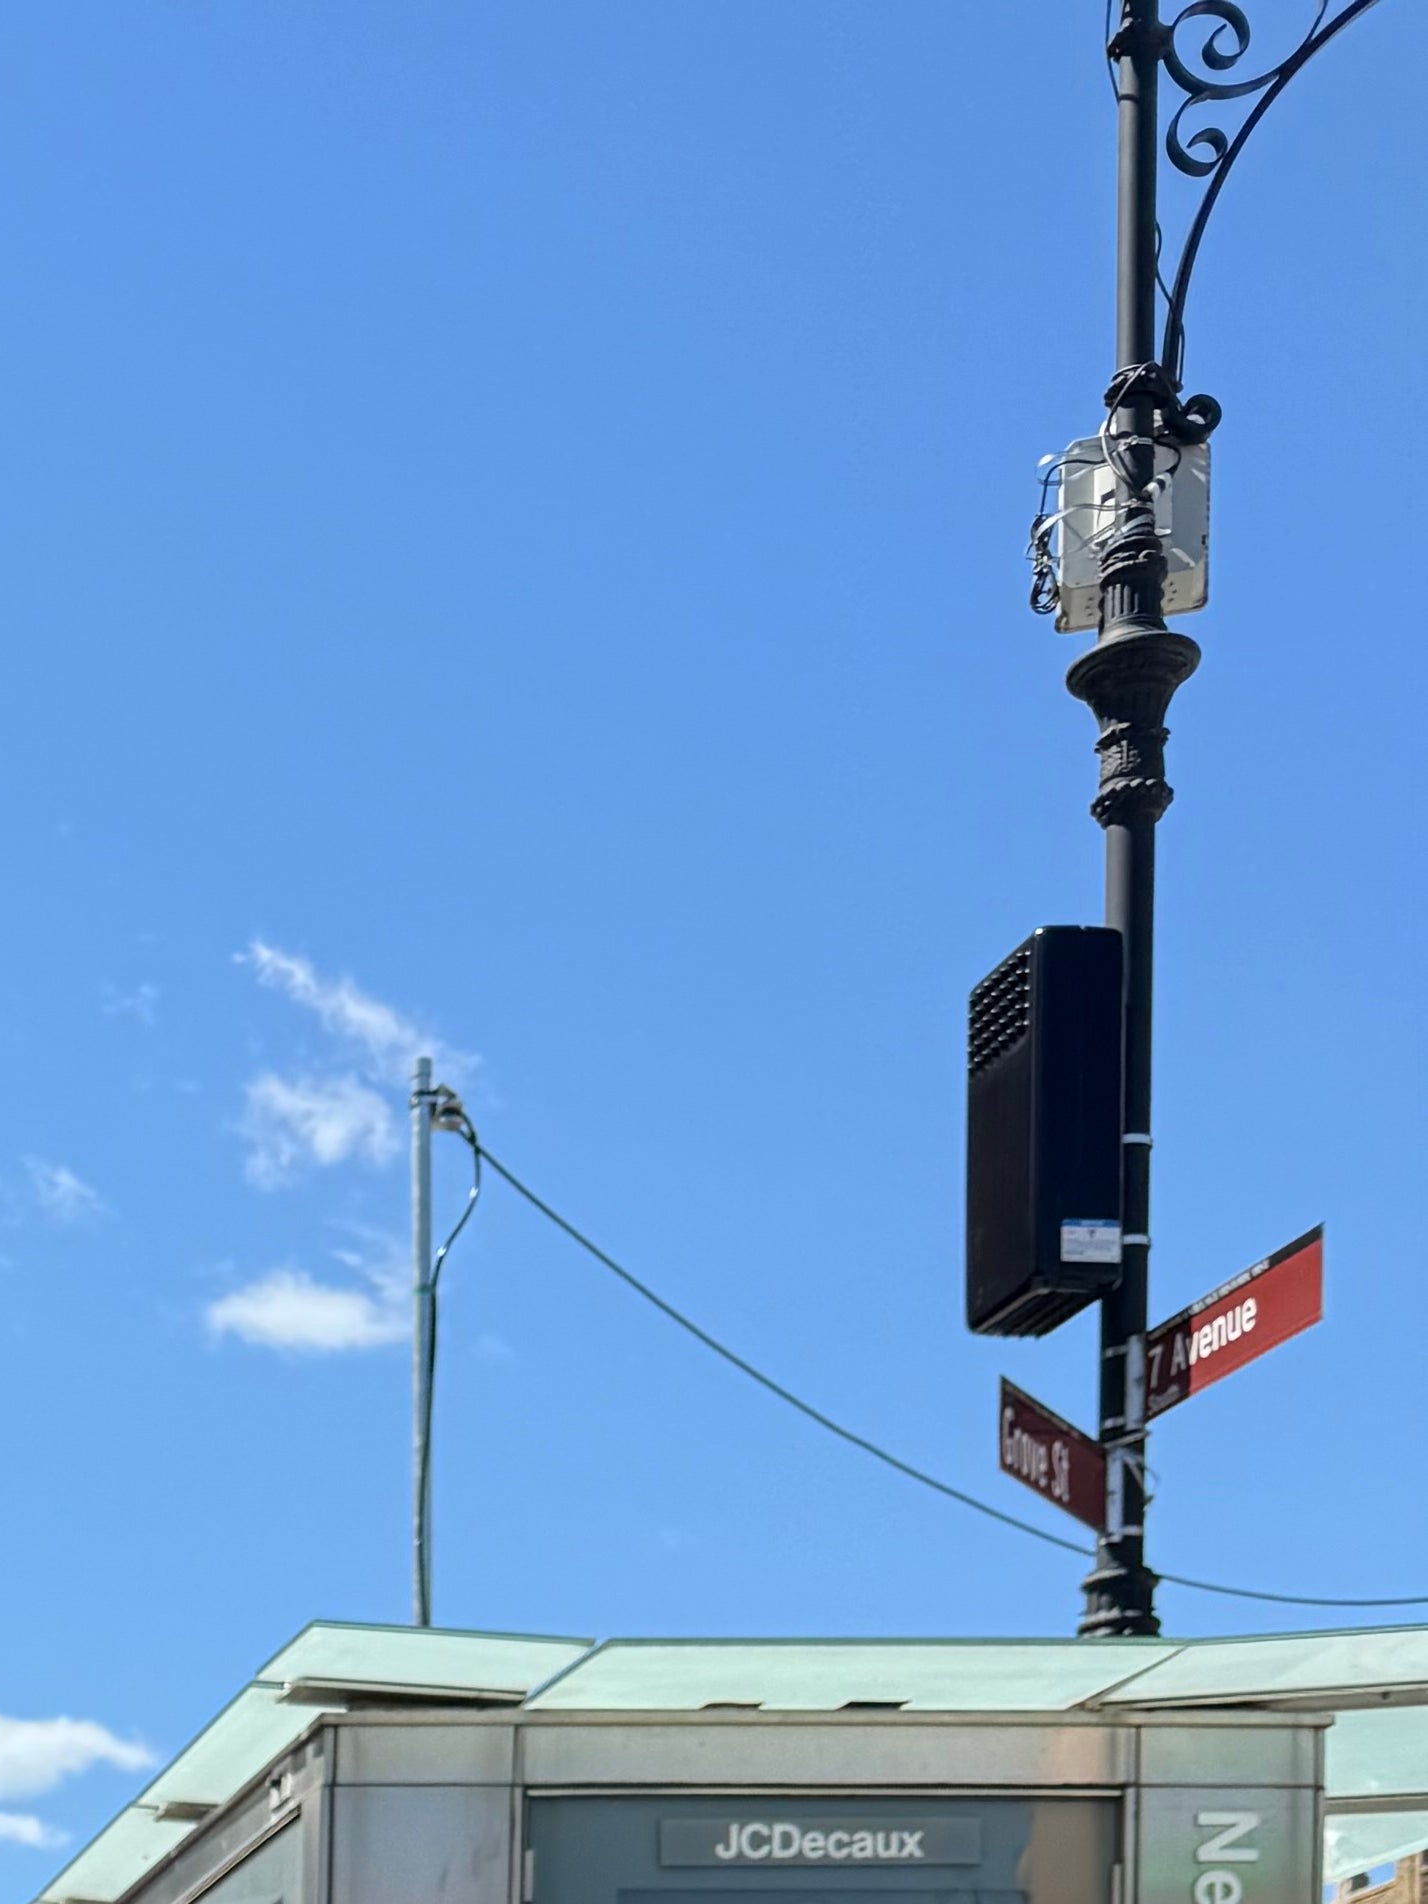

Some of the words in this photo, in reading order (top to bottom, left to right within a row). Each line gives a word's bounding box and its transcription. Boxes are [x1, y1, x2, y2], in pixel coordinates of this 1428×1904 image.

[1149, 1345, 1162, 1388] 7
[1170, 1297, 1257, 1376] Avenue
[1003, 1406, 1047, 1487] Grove
[1051, 1440, 1070, 1502] St
[714, 1822, 924, 1860] JCDecaux
